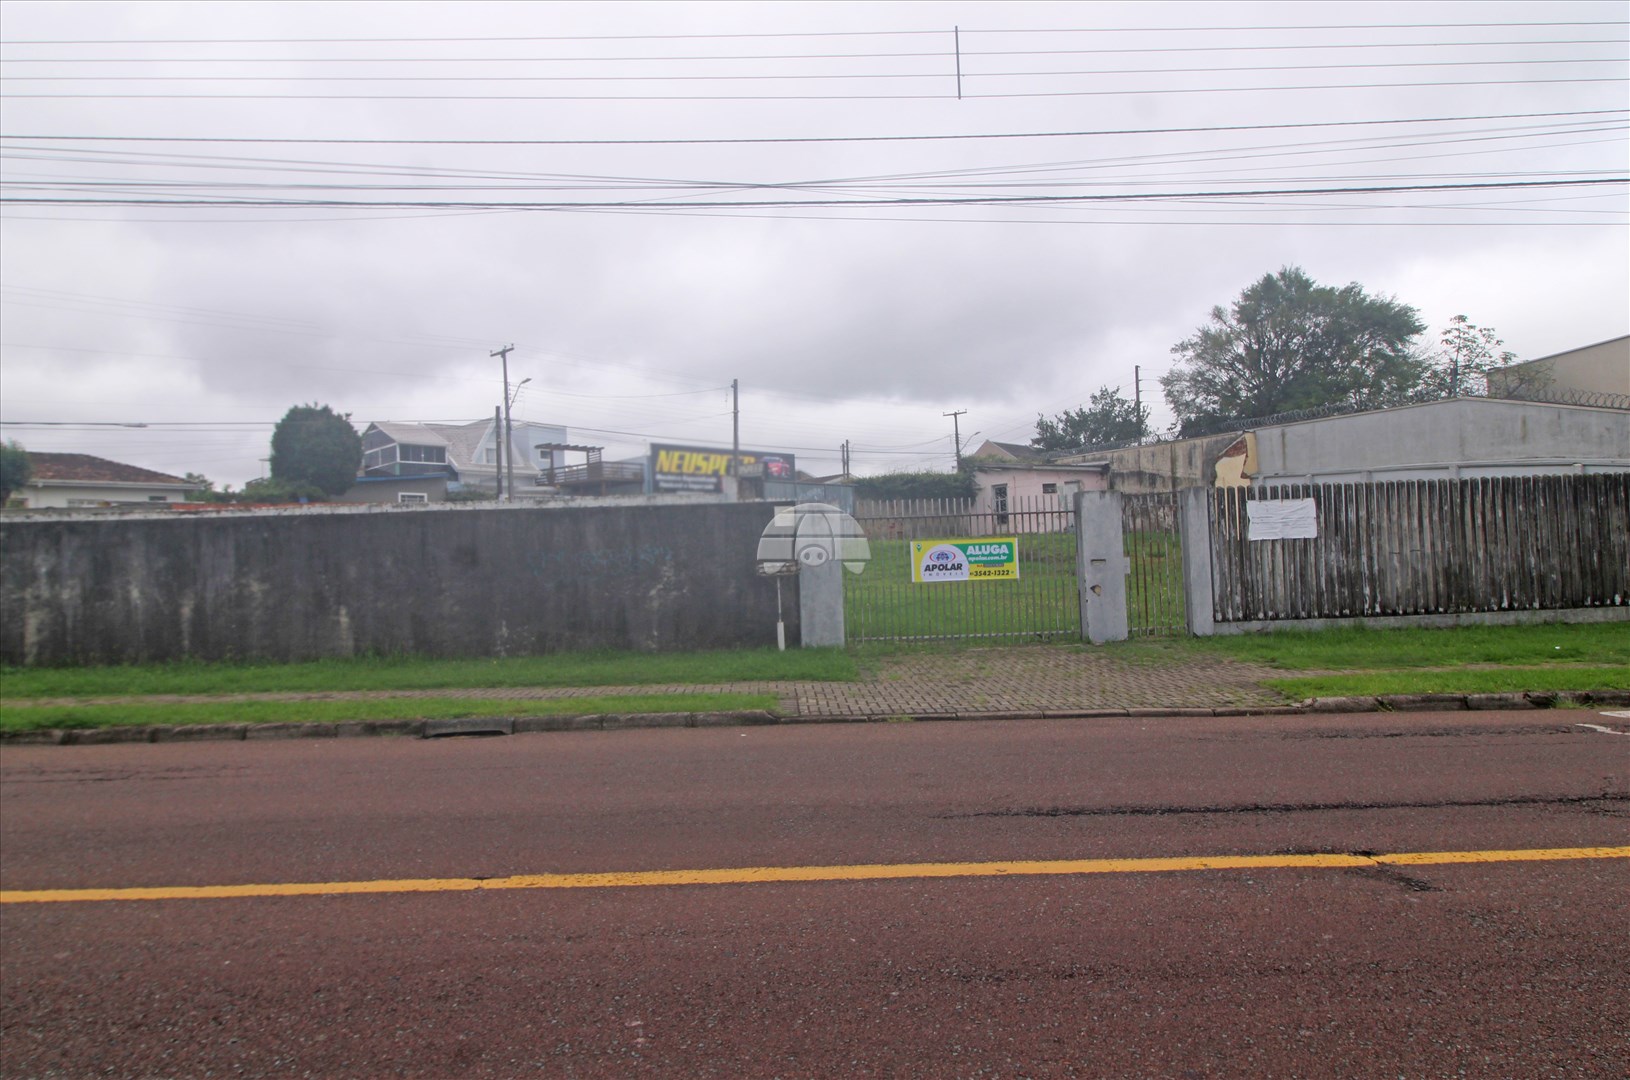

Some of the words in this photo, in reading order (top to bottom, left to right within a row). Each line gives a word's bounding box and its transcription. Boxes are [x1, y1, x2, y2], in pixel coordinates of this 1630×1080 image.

[655, 450, 756, 475] NEUSPE
[966, 544, 1009, 555] ALUGA
[924, 563, 963, 572] APOLAR
